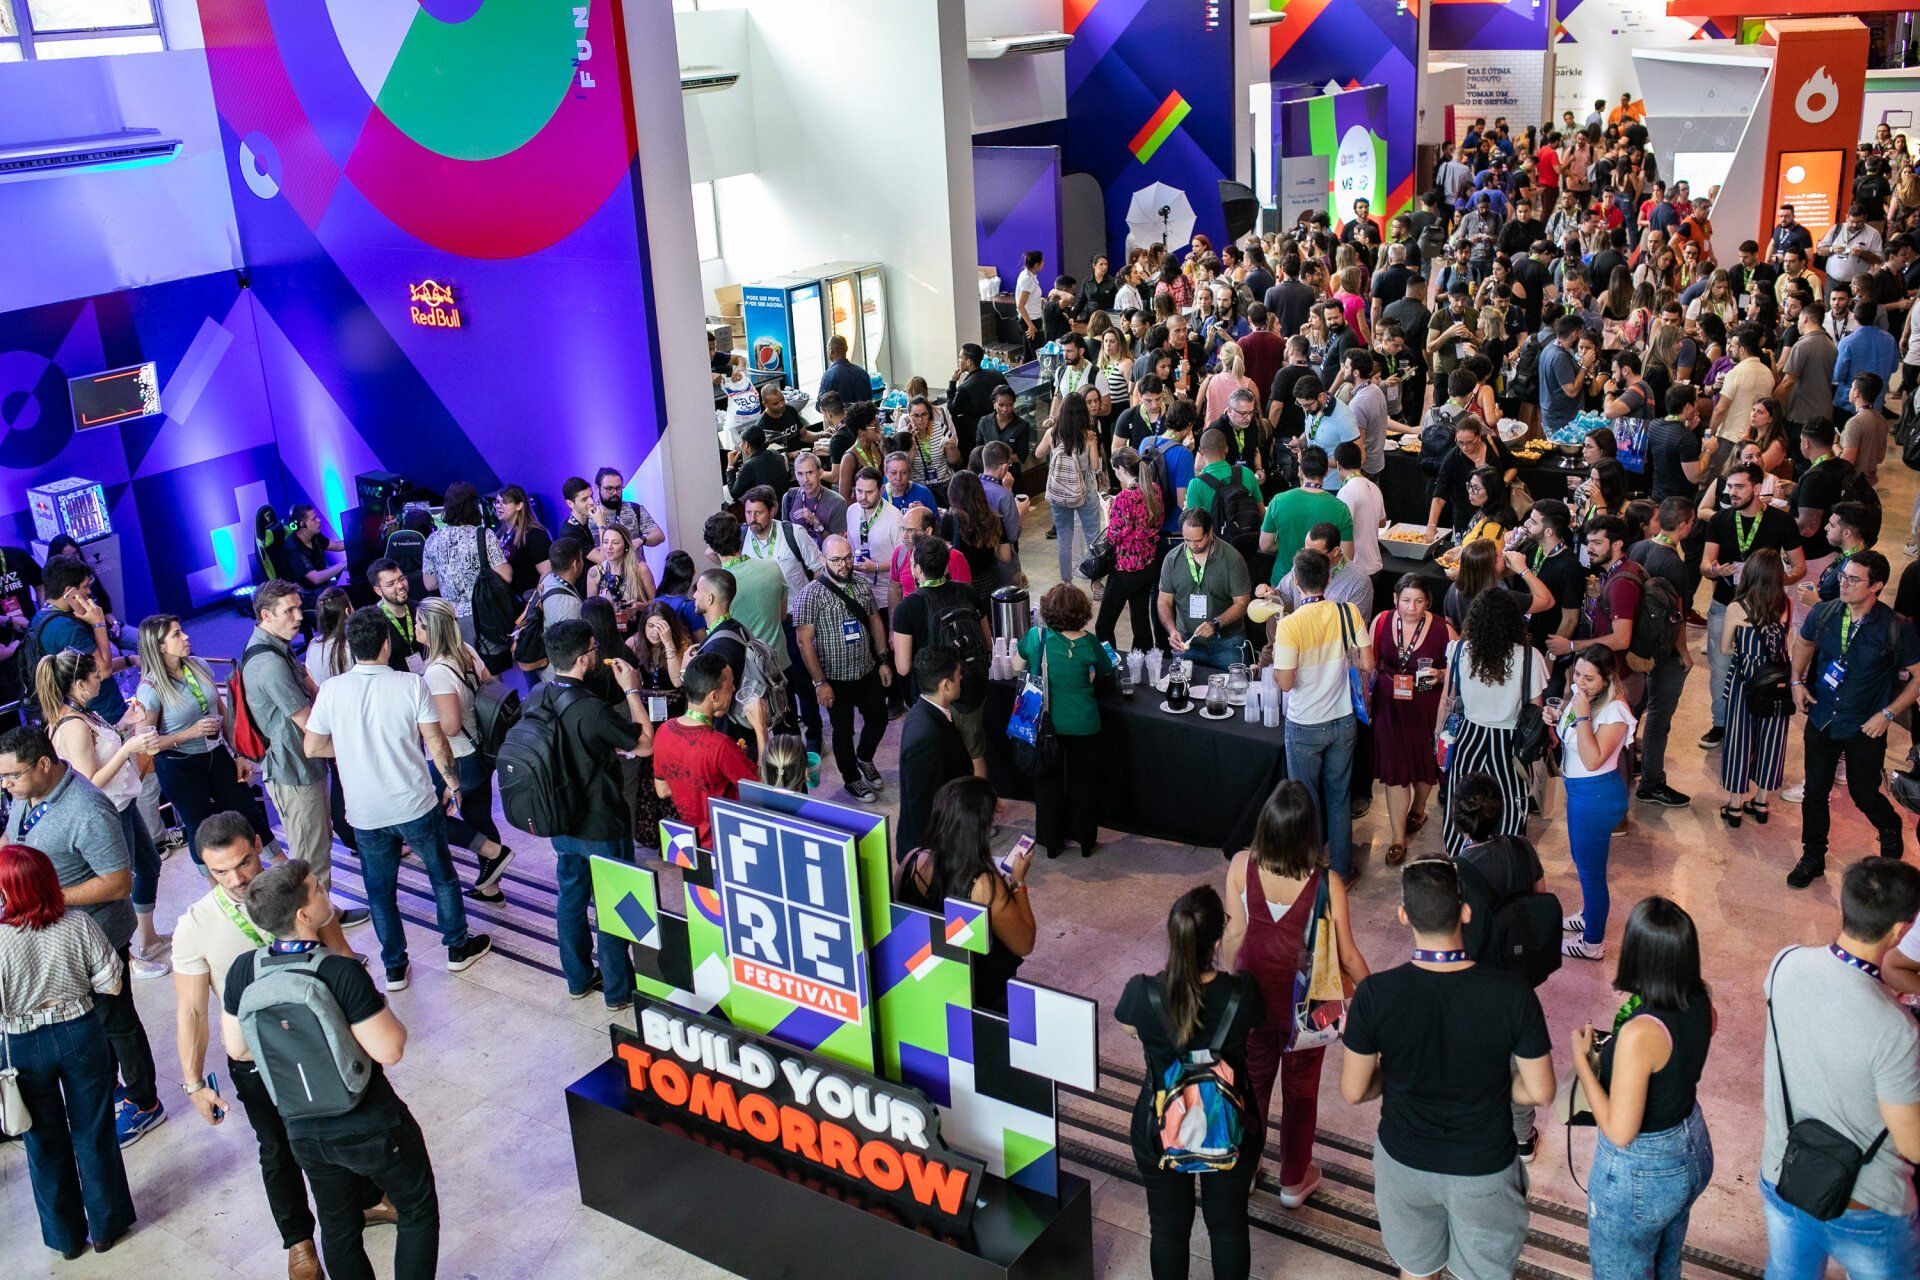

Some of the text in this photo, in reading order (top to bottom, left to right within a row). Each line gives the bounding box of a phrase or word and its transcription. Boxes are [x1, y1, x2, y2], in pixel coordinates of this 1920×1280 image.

[572, 6, 596, 88] FUN
[1487, 66, 1512, 75] ÓTIMA
[411, 306, 460, 328] Red Bull
[4, 580, 24, 592] FIRE
[743, 963, 848, 1014] FESTIVAL
[640, 1007, 931, 1150] BUILD YOUR
[616, 1042, 971, 1216] TOMORROW
